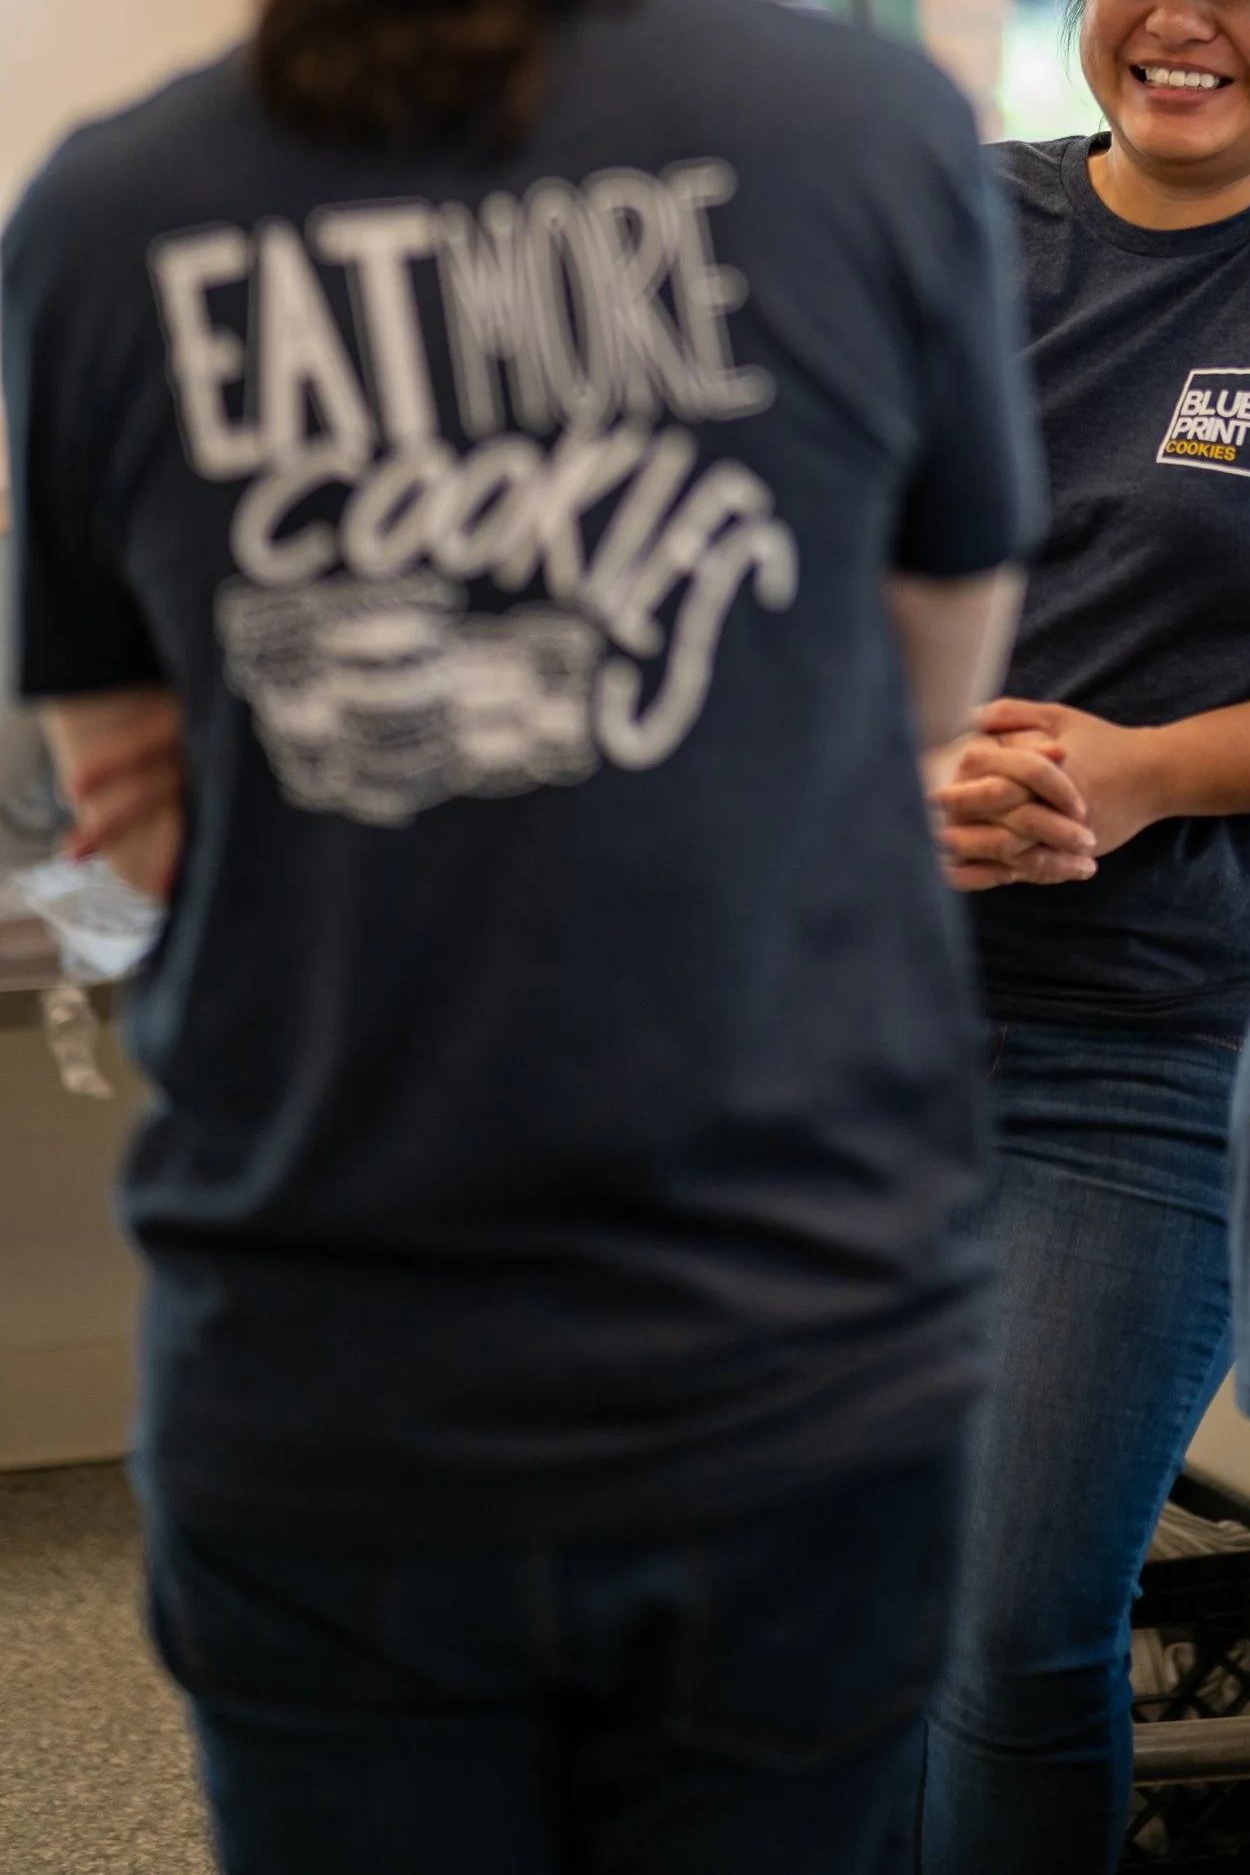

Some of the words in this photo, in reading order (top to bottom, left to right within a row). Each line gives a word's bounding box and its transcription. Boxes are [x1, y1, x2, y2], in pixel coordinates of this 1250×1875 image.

[150, 201, 437, 480] EAT
[437, 159, 776, 431] MORE
[1165, 440, 1237, 461] COOKIES
